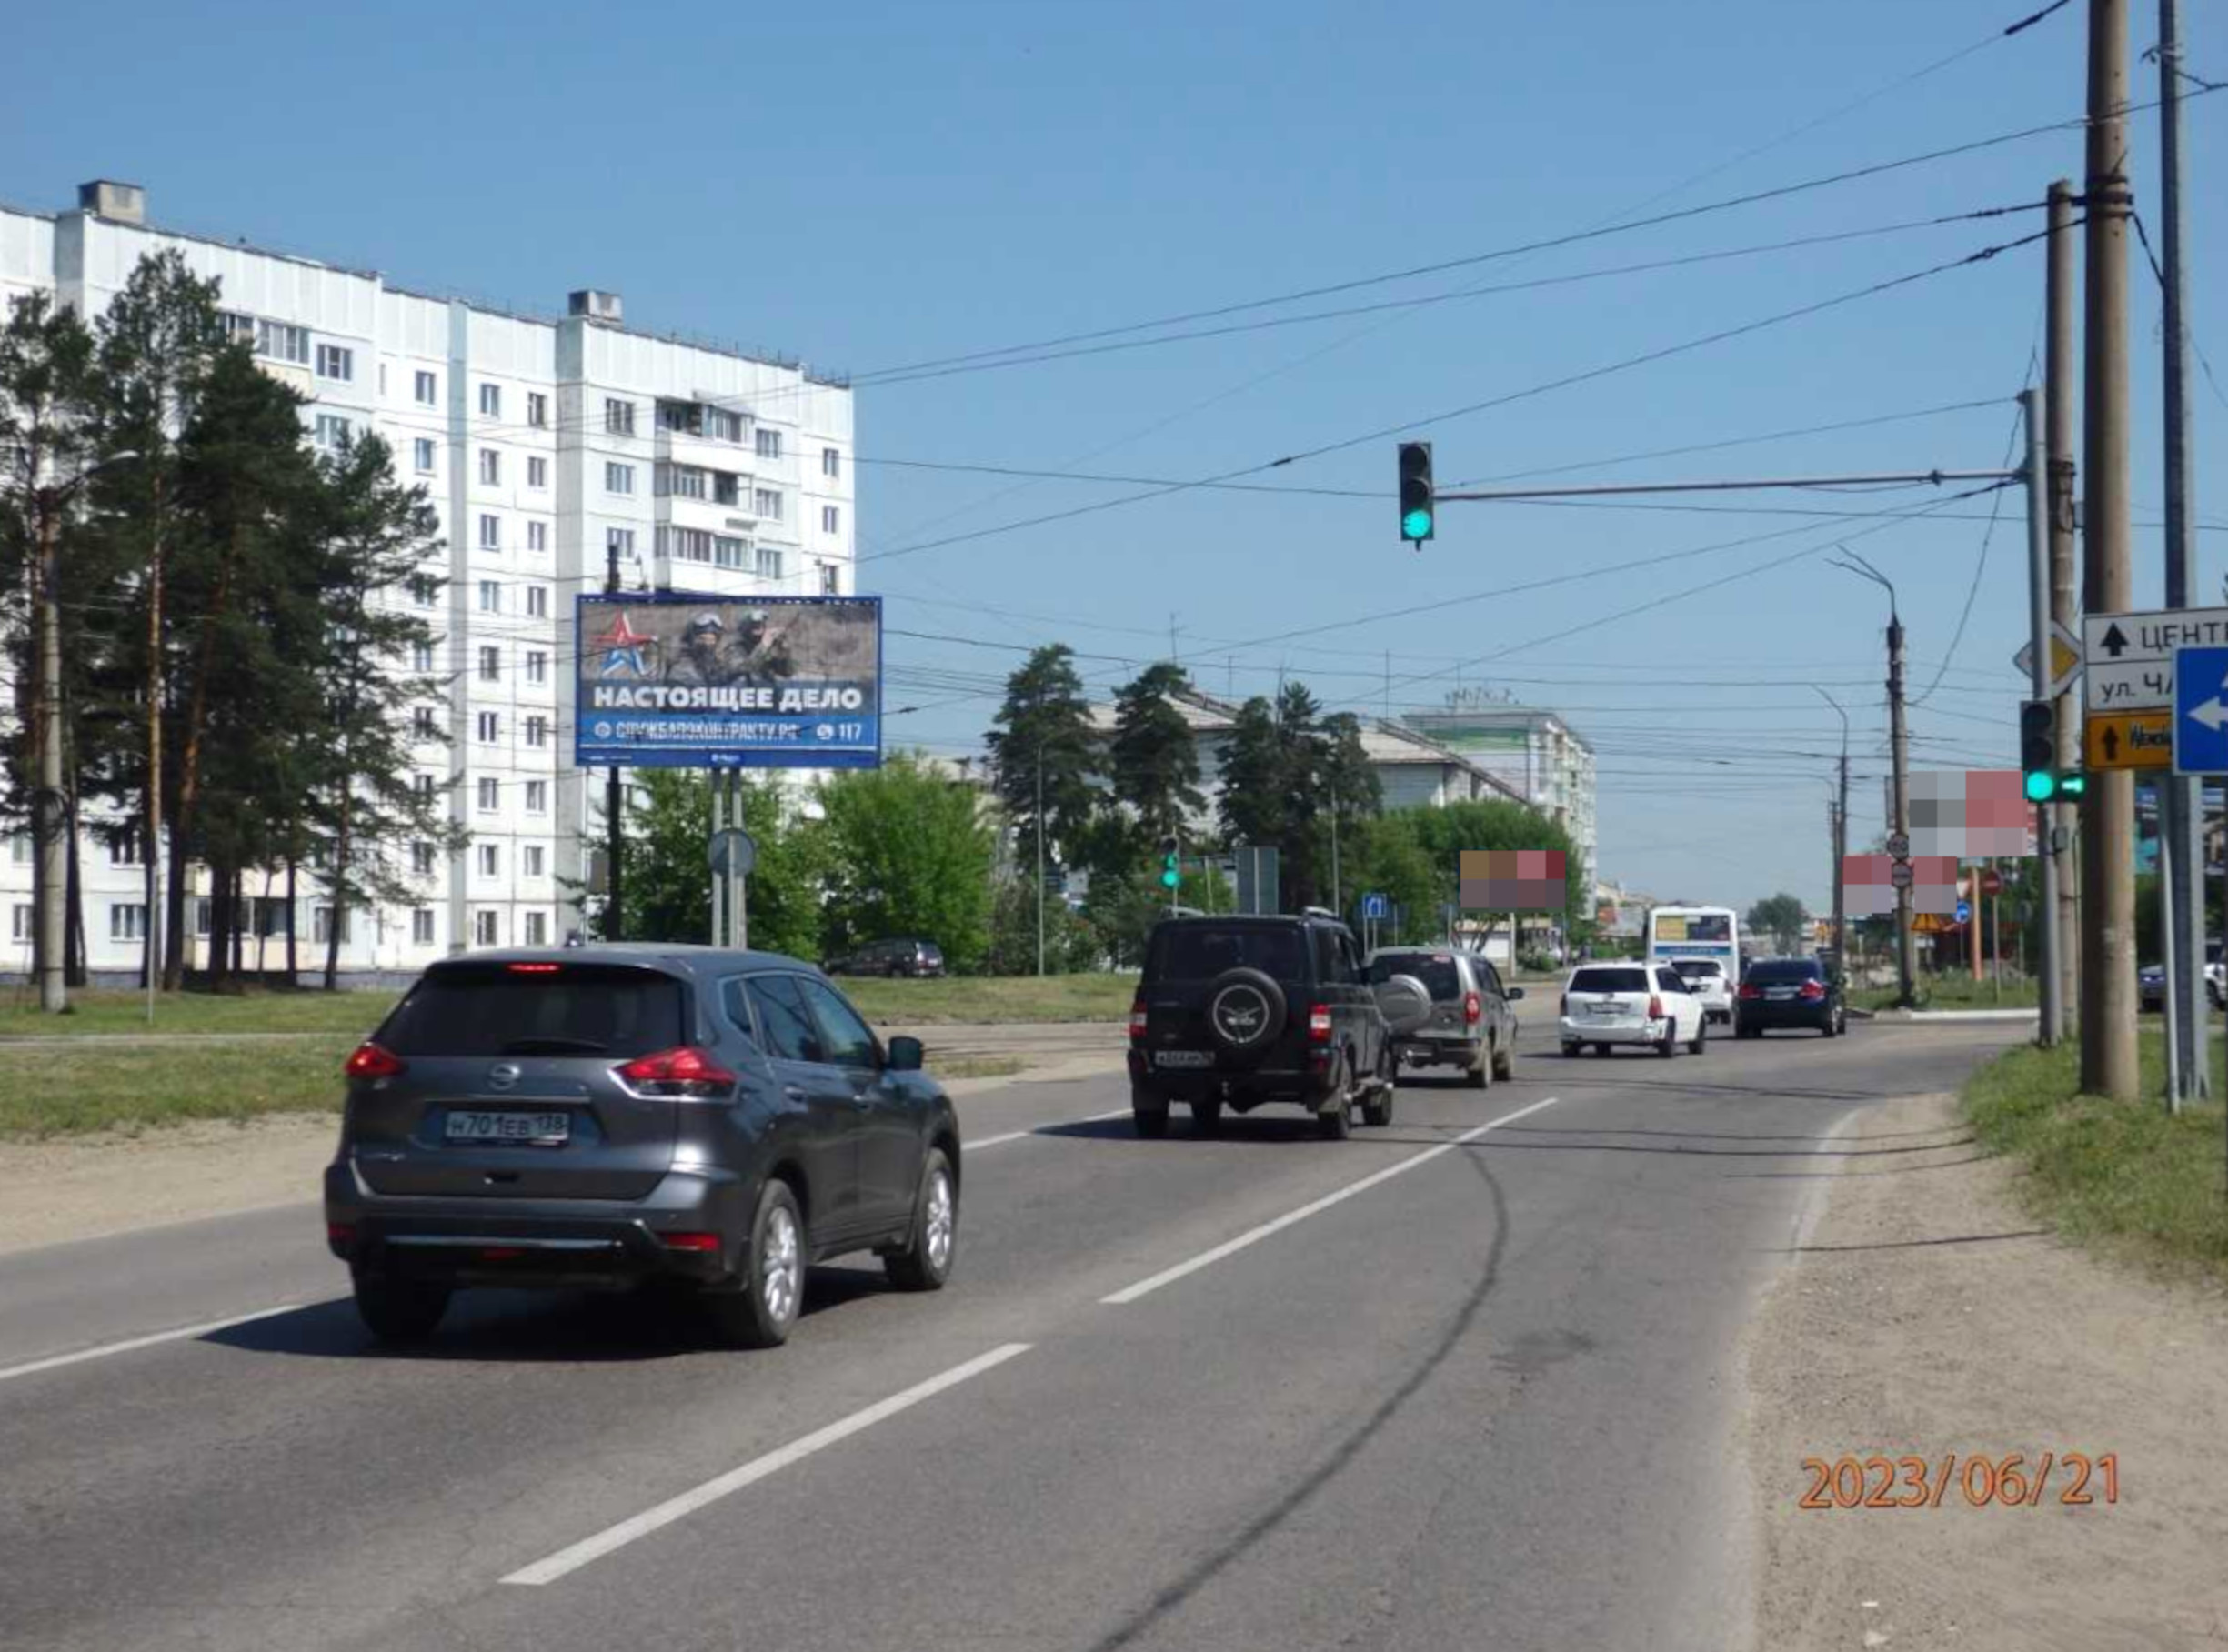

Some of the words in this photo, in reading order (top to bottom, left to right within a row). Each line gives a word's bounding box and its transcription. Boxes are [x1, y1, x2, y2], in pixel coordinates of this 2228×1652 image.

[2142, 622, 2228, 653] ЦЕНТ
[594, 686, 774, 711] НАСТОЯЩЕЕ
[779, 687, 862, 712] ДЕЛО
[2101, 682, 2135, 703] ул.
[838, 724, 862, 740] 117
